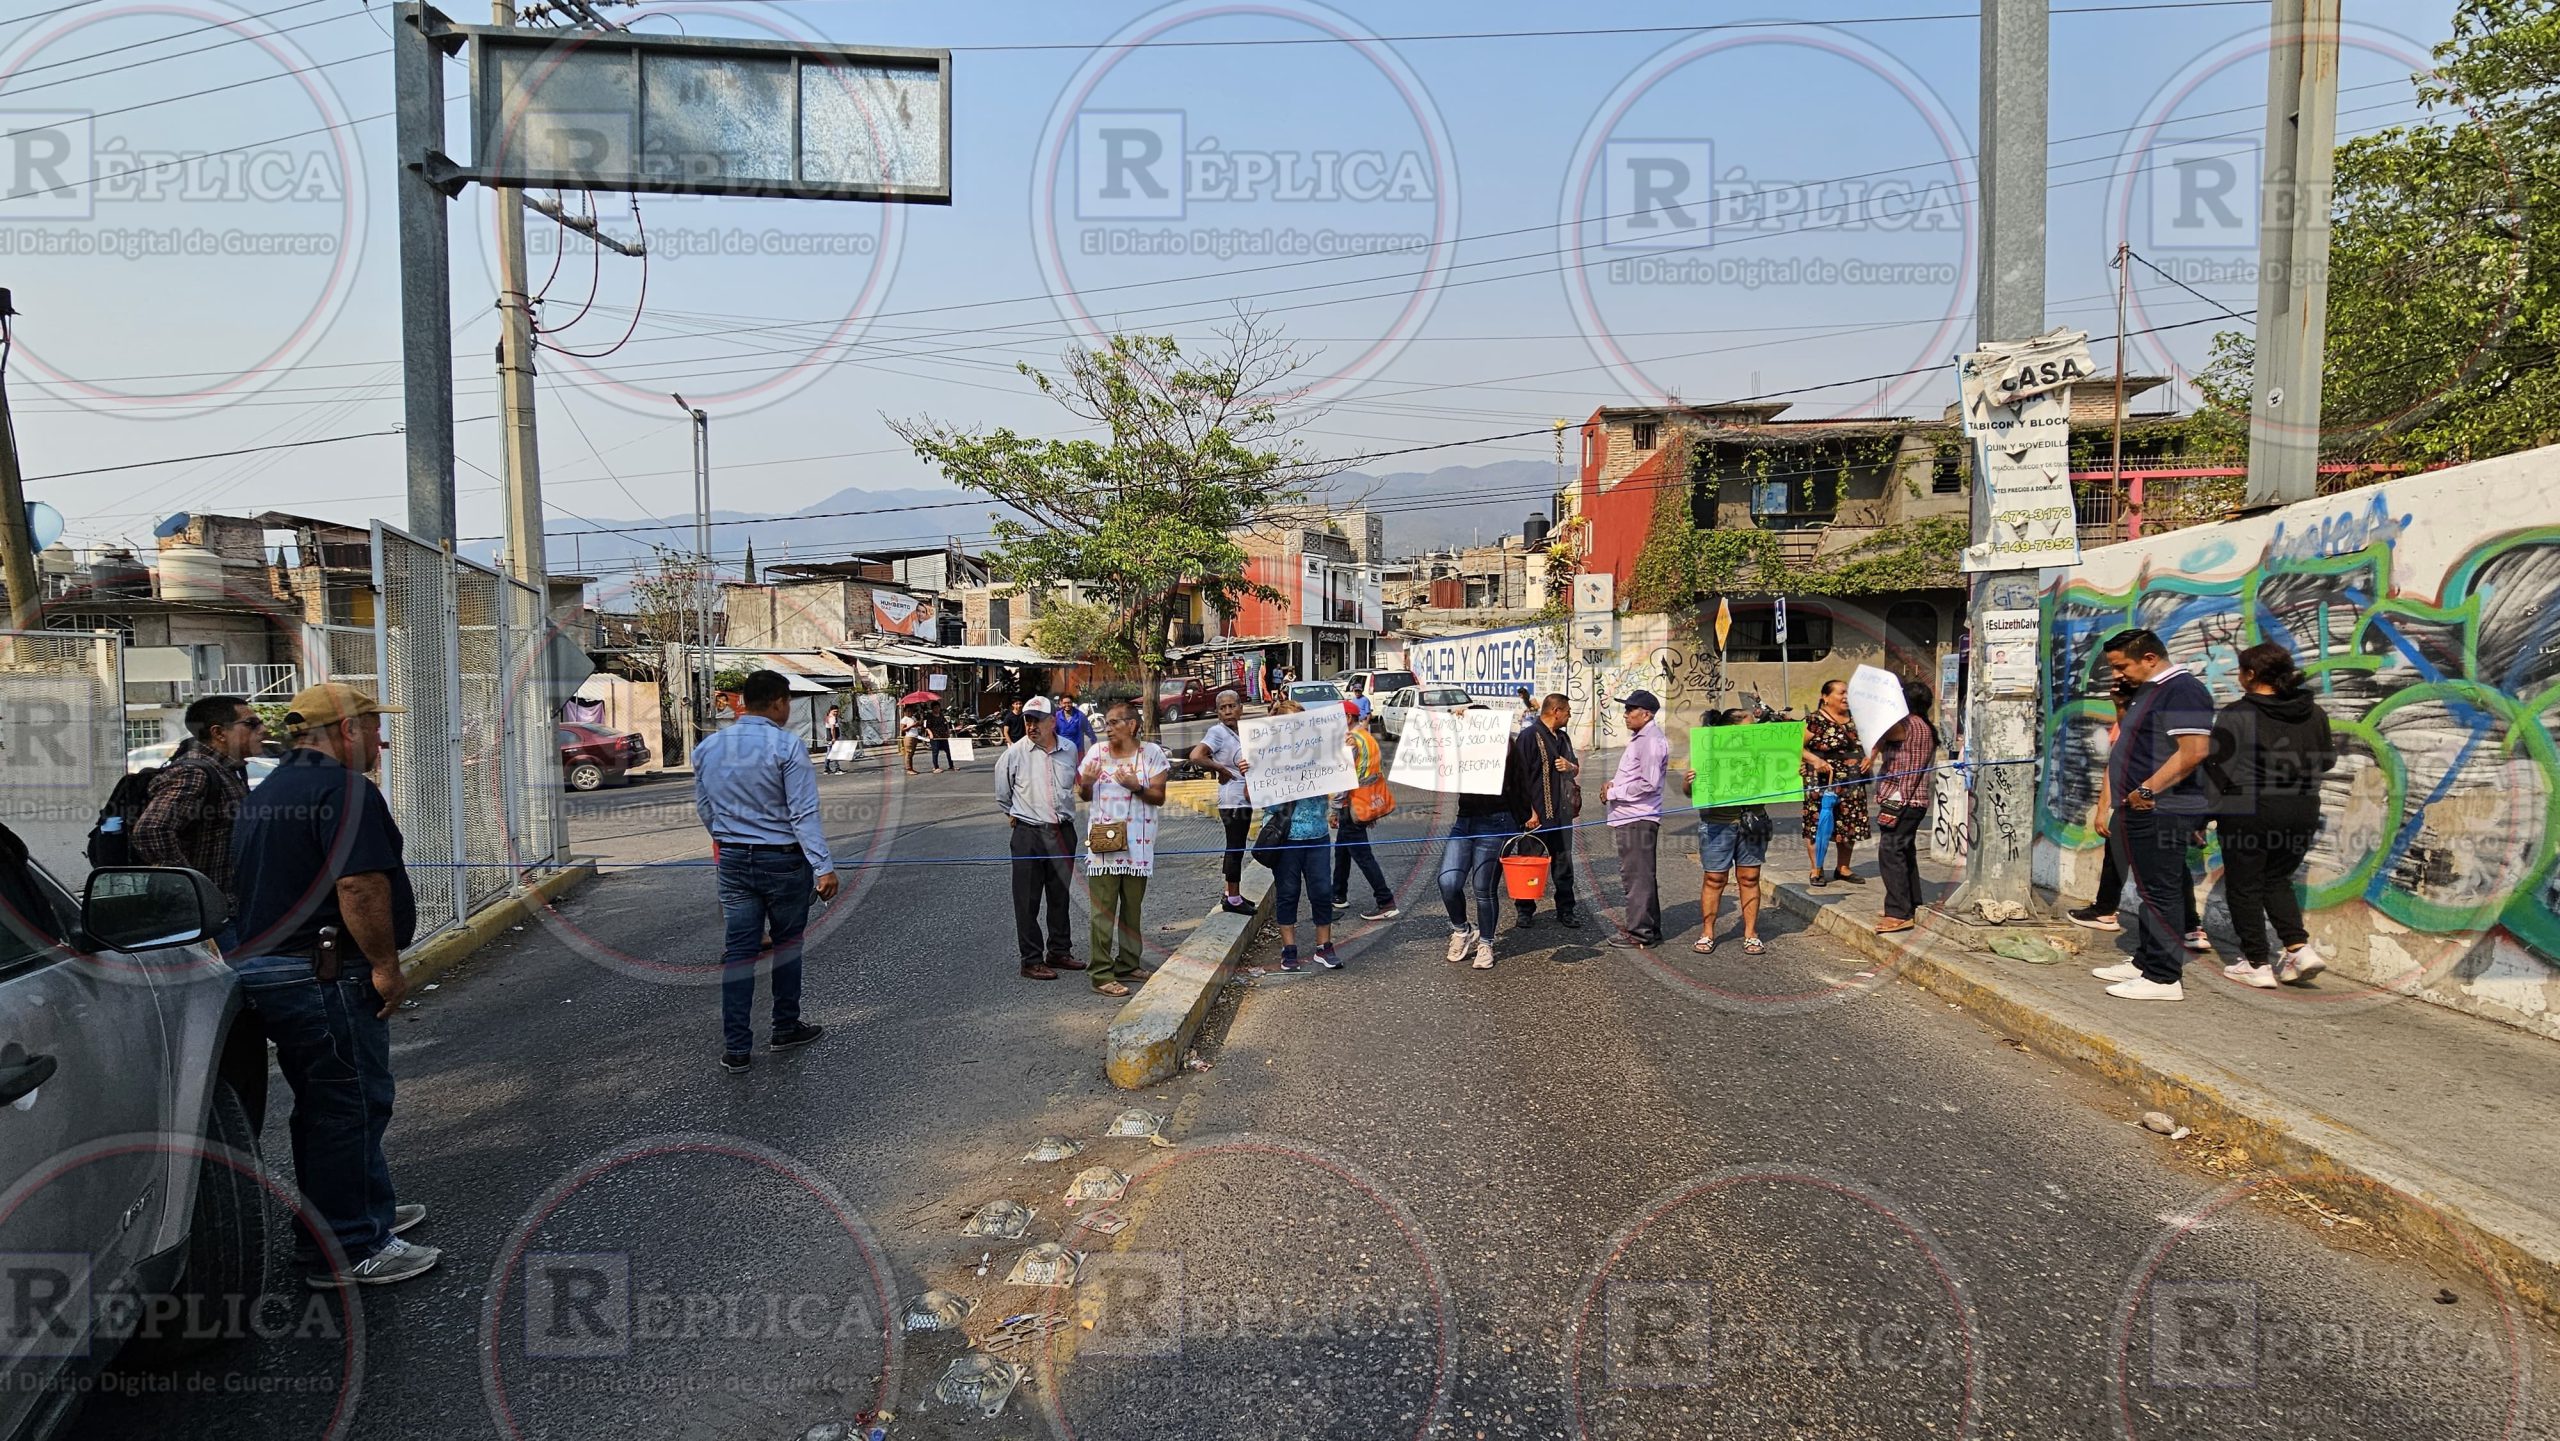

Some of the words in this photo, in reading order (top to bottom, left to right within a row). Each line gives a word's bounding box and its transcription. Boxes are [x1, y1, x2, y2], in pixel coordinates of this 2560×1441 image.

[1968, 421, 2014, 430] TABICON
[2018, 420, 2025, 428] Y
[2030, 417, 2069, 428] BLOCK
[2035, 484, 2063, 492] DOMICILIO
[1426, 647, 1455, 681] ALFA
[1461, 646, 1469, 681] Y
[1476, 638, 1536, 681] OMEGA
[1468, 715, 1500, 731] AGUA
[1729, 724, 1801, 747] REFORMA
[1458, 759, 1501, 773] REFORMA
